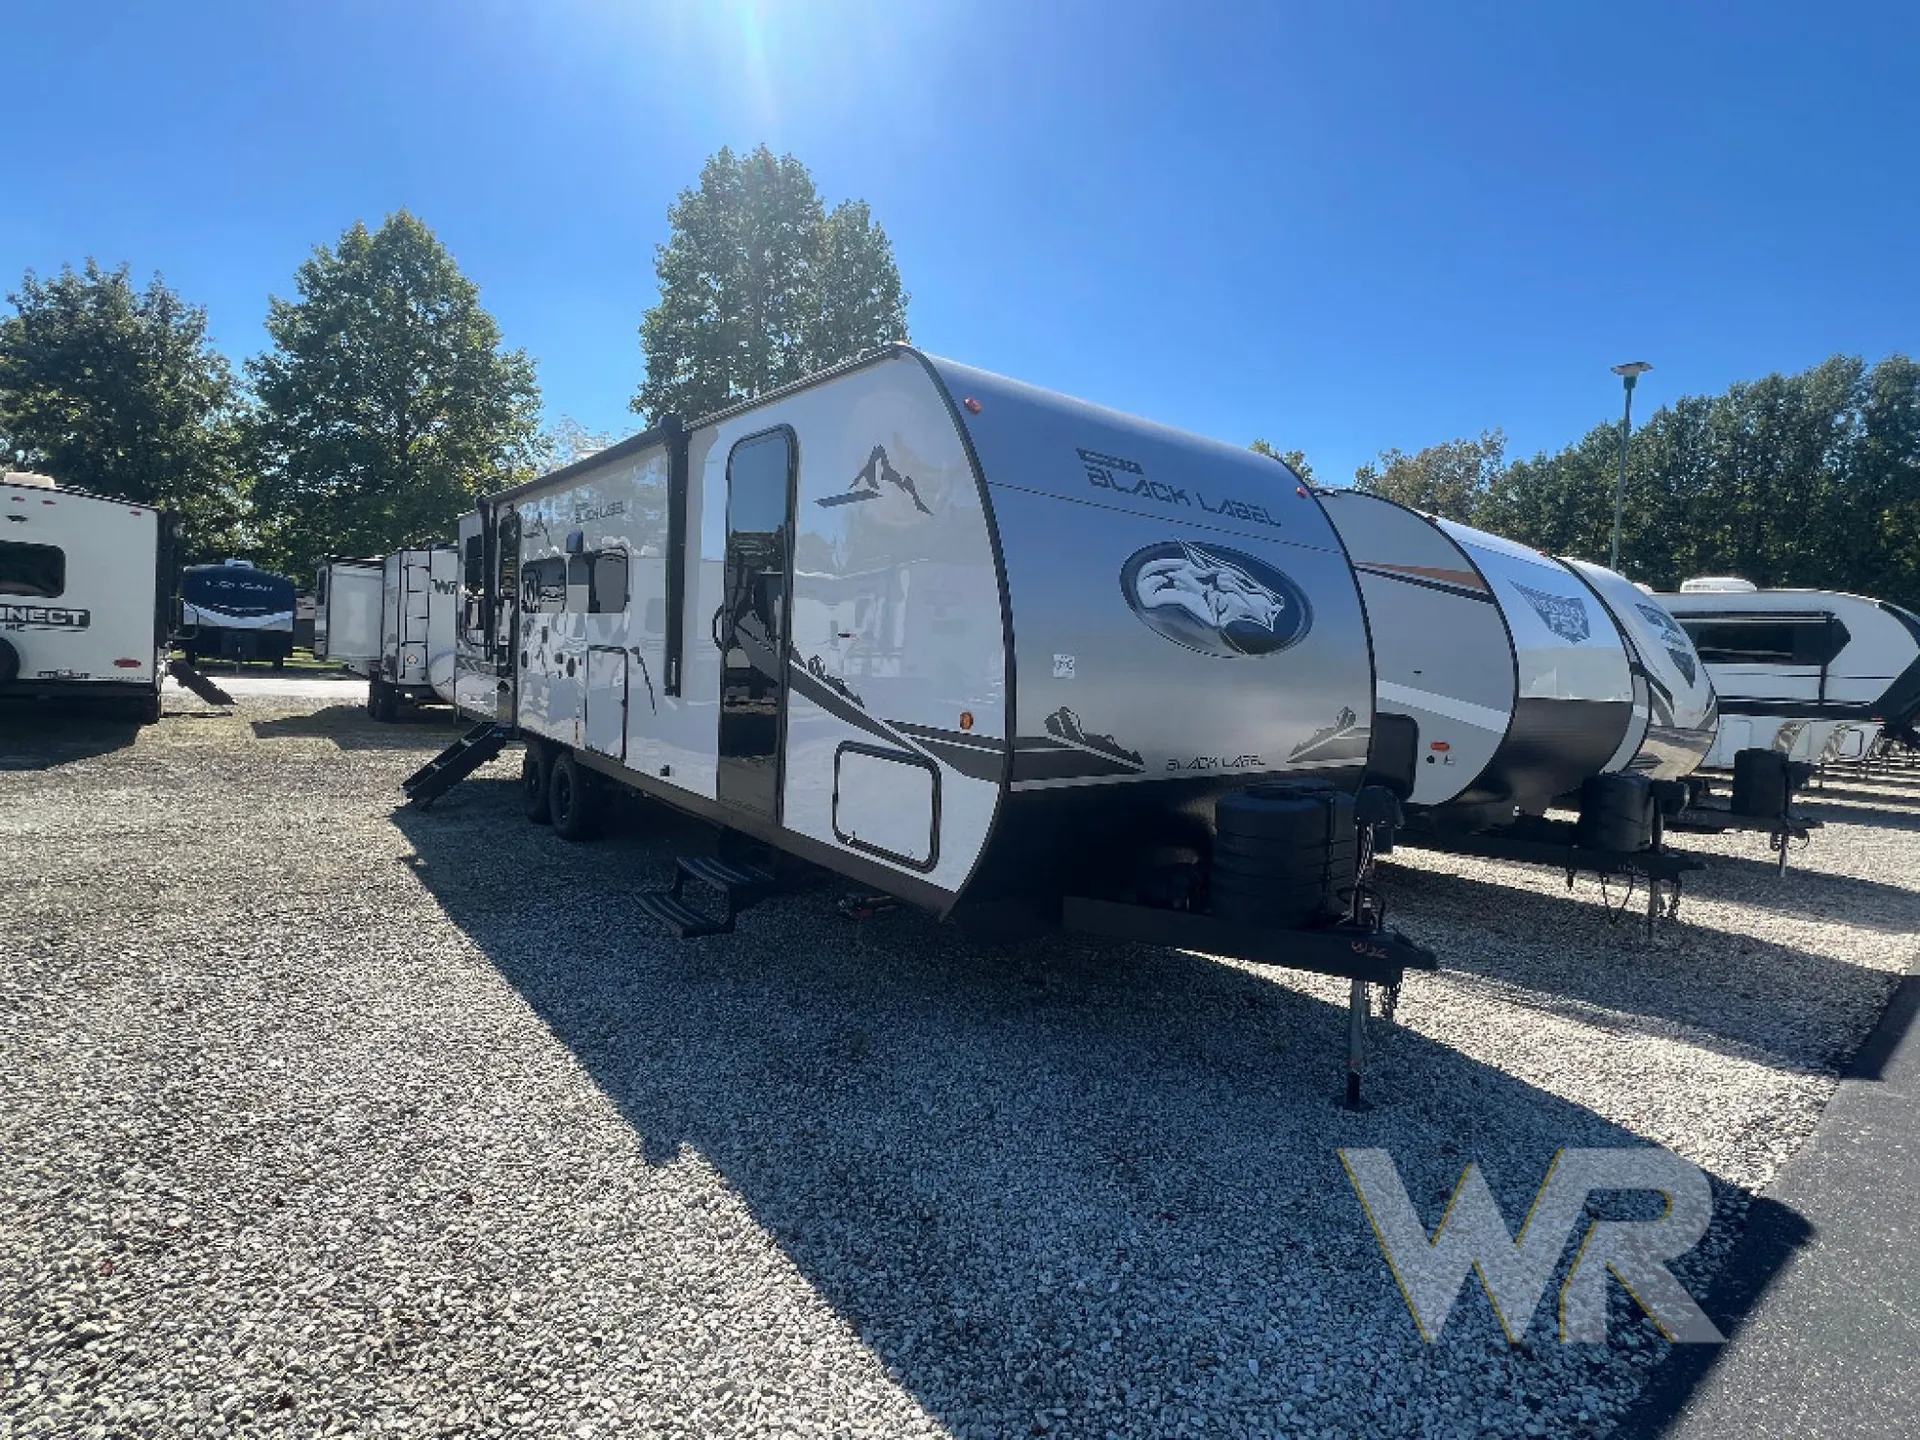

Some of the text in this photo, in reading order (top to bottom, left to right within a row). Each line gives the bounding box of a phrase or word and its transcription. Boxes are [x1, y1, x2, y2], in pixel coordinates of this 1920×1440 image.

[1084, 463, 1282, 528] BLACK LABEL
[1165, 754, 1267, 772] BLACK LABEL
